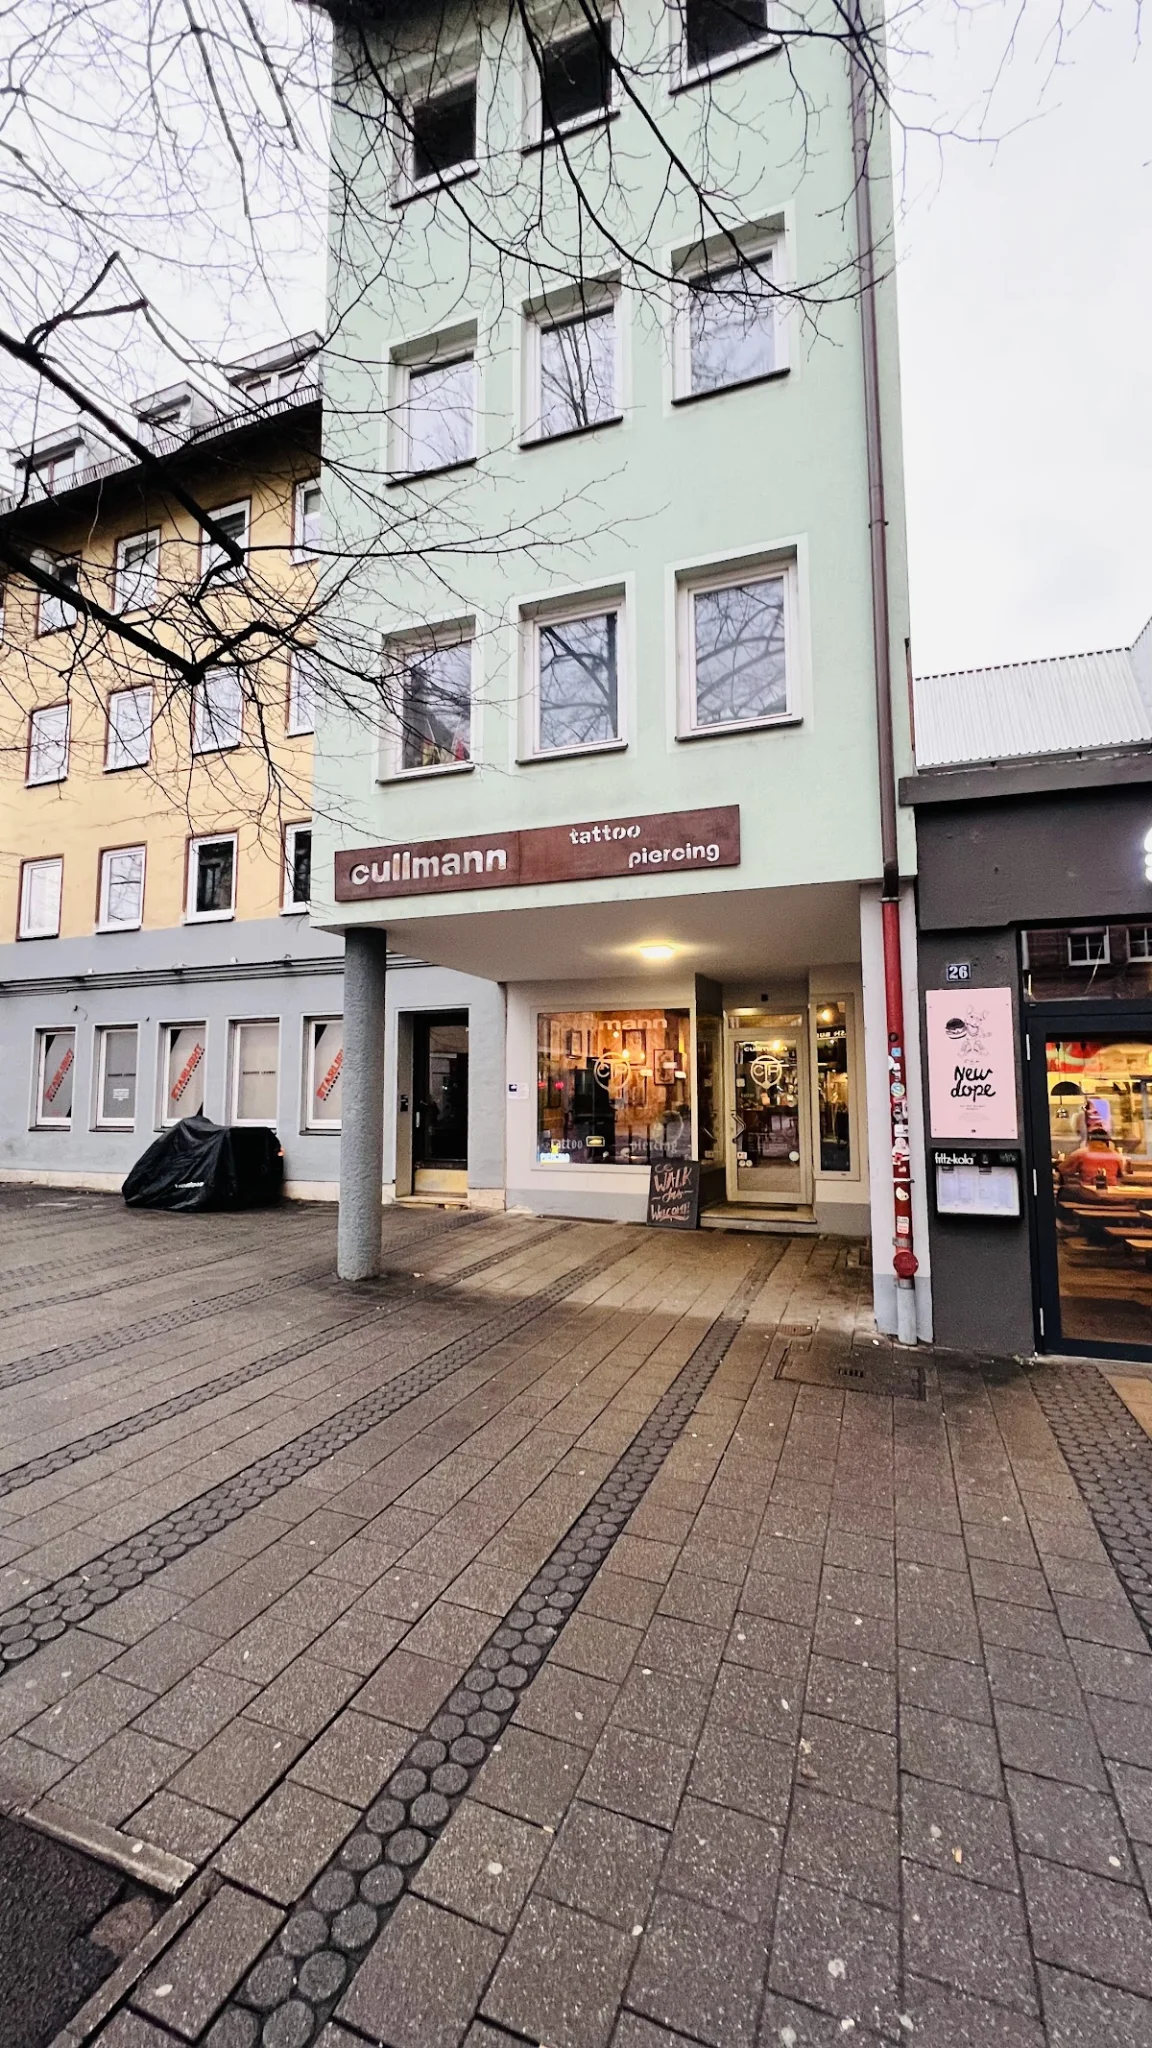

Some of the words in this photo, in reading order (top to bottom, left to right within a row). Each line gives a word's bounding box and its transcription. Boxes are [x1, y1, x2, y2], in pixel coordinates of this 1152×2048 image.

[569, 824, 641, 844] tattoo
[628, 842, 720, 868] piercing
[351, 849, 507, 885] cullmann
[948, 965, 969, 980] 26
[171, 1042, 203, 1100] STARLIGHT
[954, 1065, 993, 1081] New
[950, 1080, 996, 1103] dope
[934, 1152, 975, 1166] fritz-kola
[653, 1166, 693, 1192] WALK
